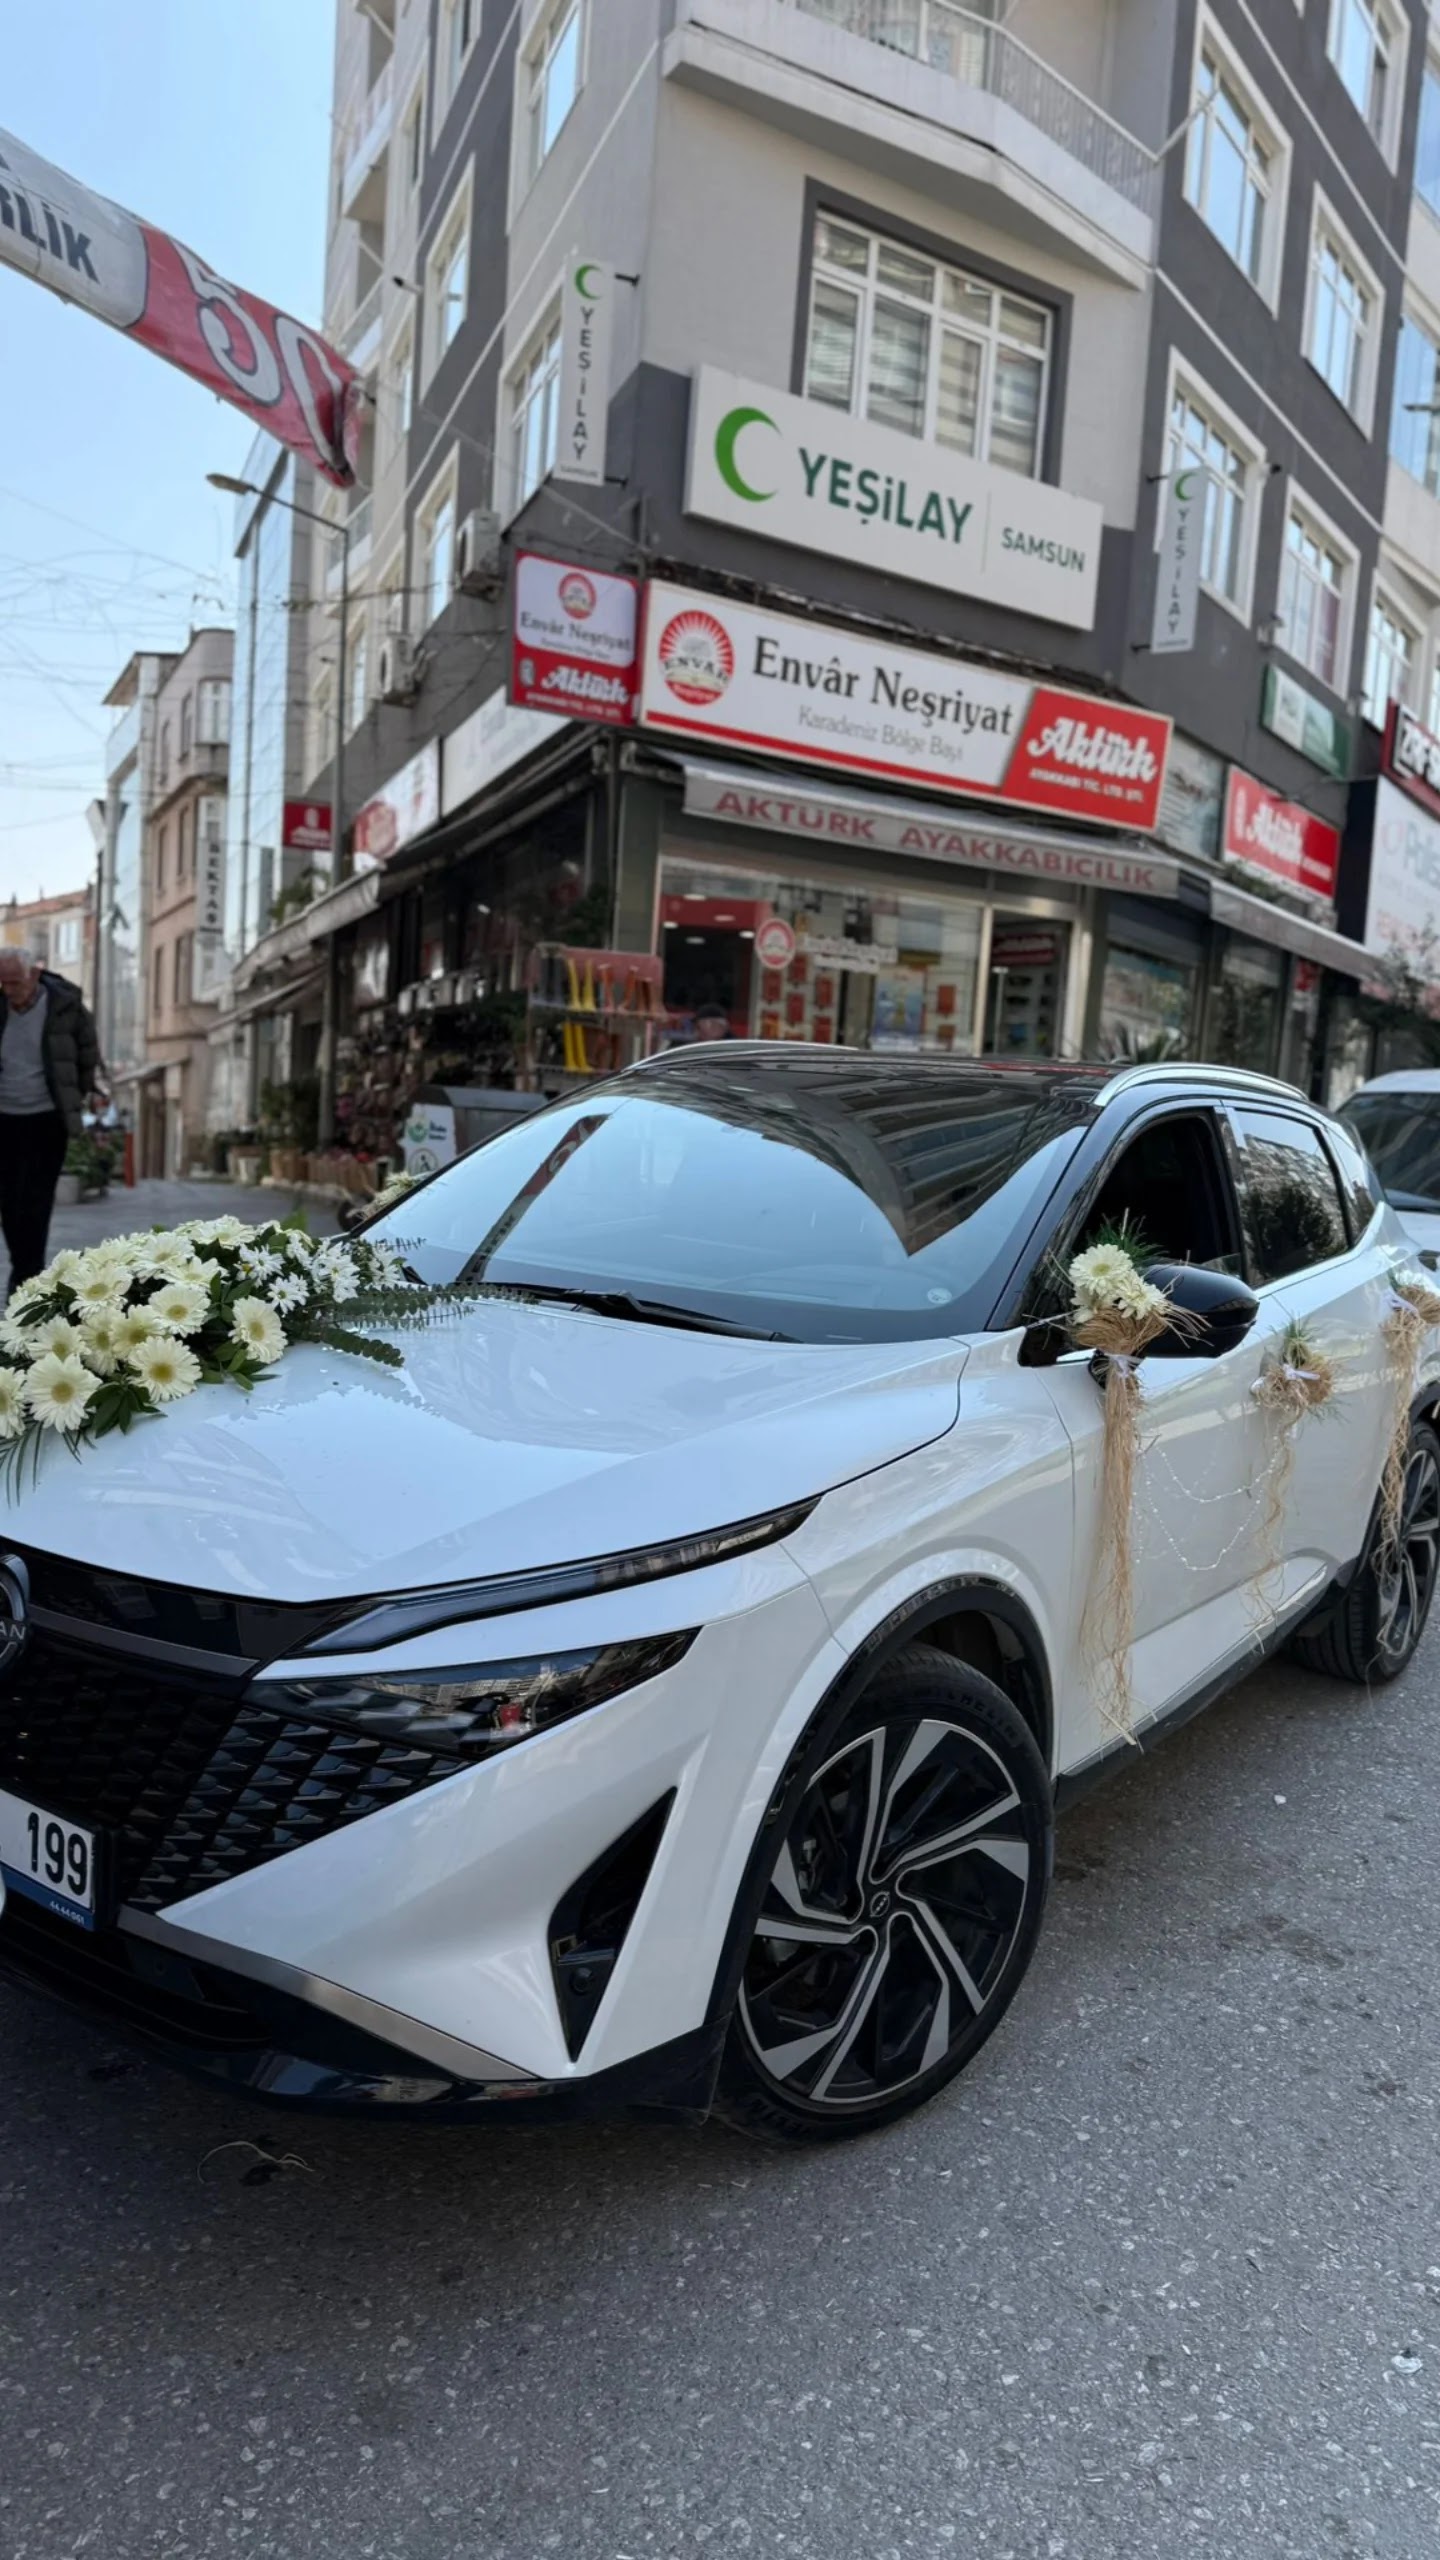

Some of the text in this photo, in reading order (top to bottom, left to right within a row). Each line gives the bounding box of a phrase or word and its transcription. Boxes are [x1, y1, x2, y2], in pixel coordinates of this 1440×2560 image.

[1001, 527, 1086, 573] SAMSUN
[752, 635, 1014, 736] Envâr Neşriyat
[798, 704, 878, 742] Karadeniz
[880, 723, 927, 755] Bölge
[27, 1811, 89, 1897] 199
